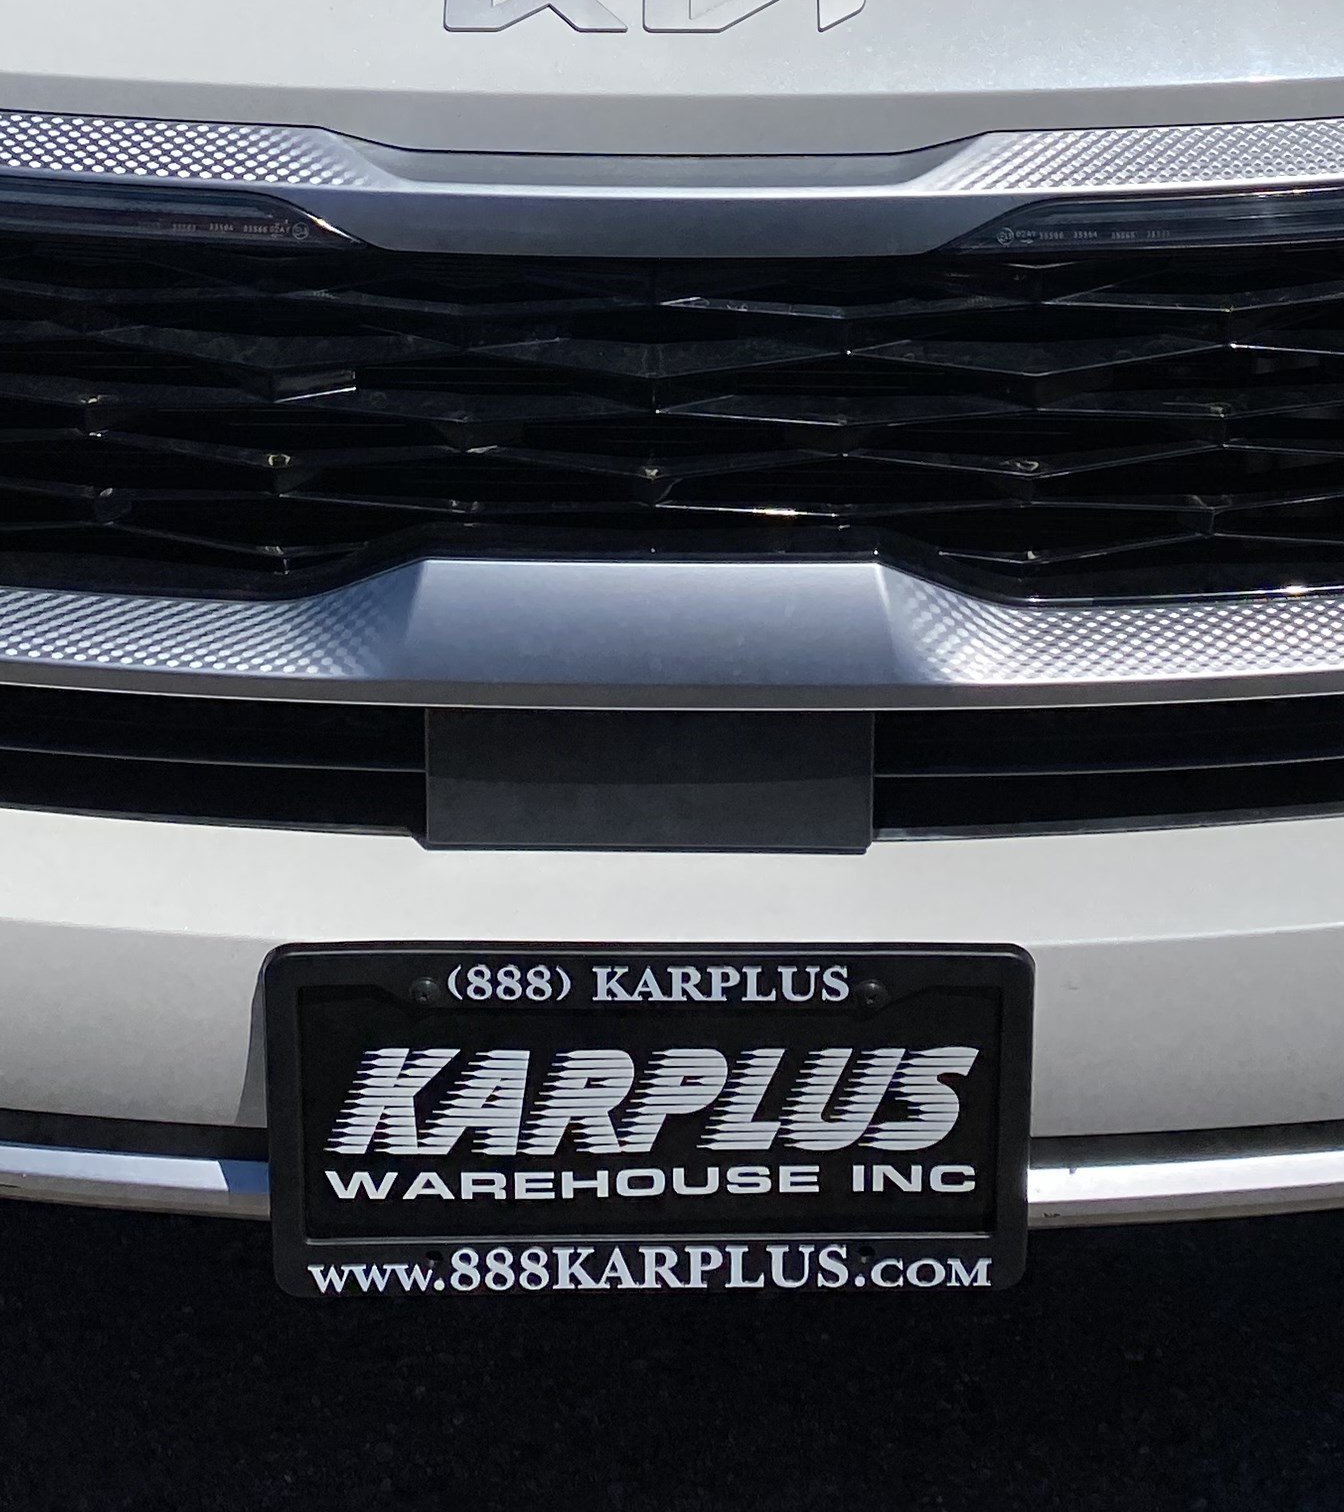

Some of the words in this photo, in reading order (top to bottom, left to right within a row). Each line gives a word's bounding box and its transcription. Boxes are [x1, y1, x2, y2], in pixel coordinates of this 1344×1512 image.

[447, 964, 571, 1001] (888)
[591, 965, 850, 1002] KARPLUS
[325, 1047, 979, 1155] KARPLUS
[324, 1165, 820, 1200] WAREHOUSE
[851, 1164, 977, 1193] INC
